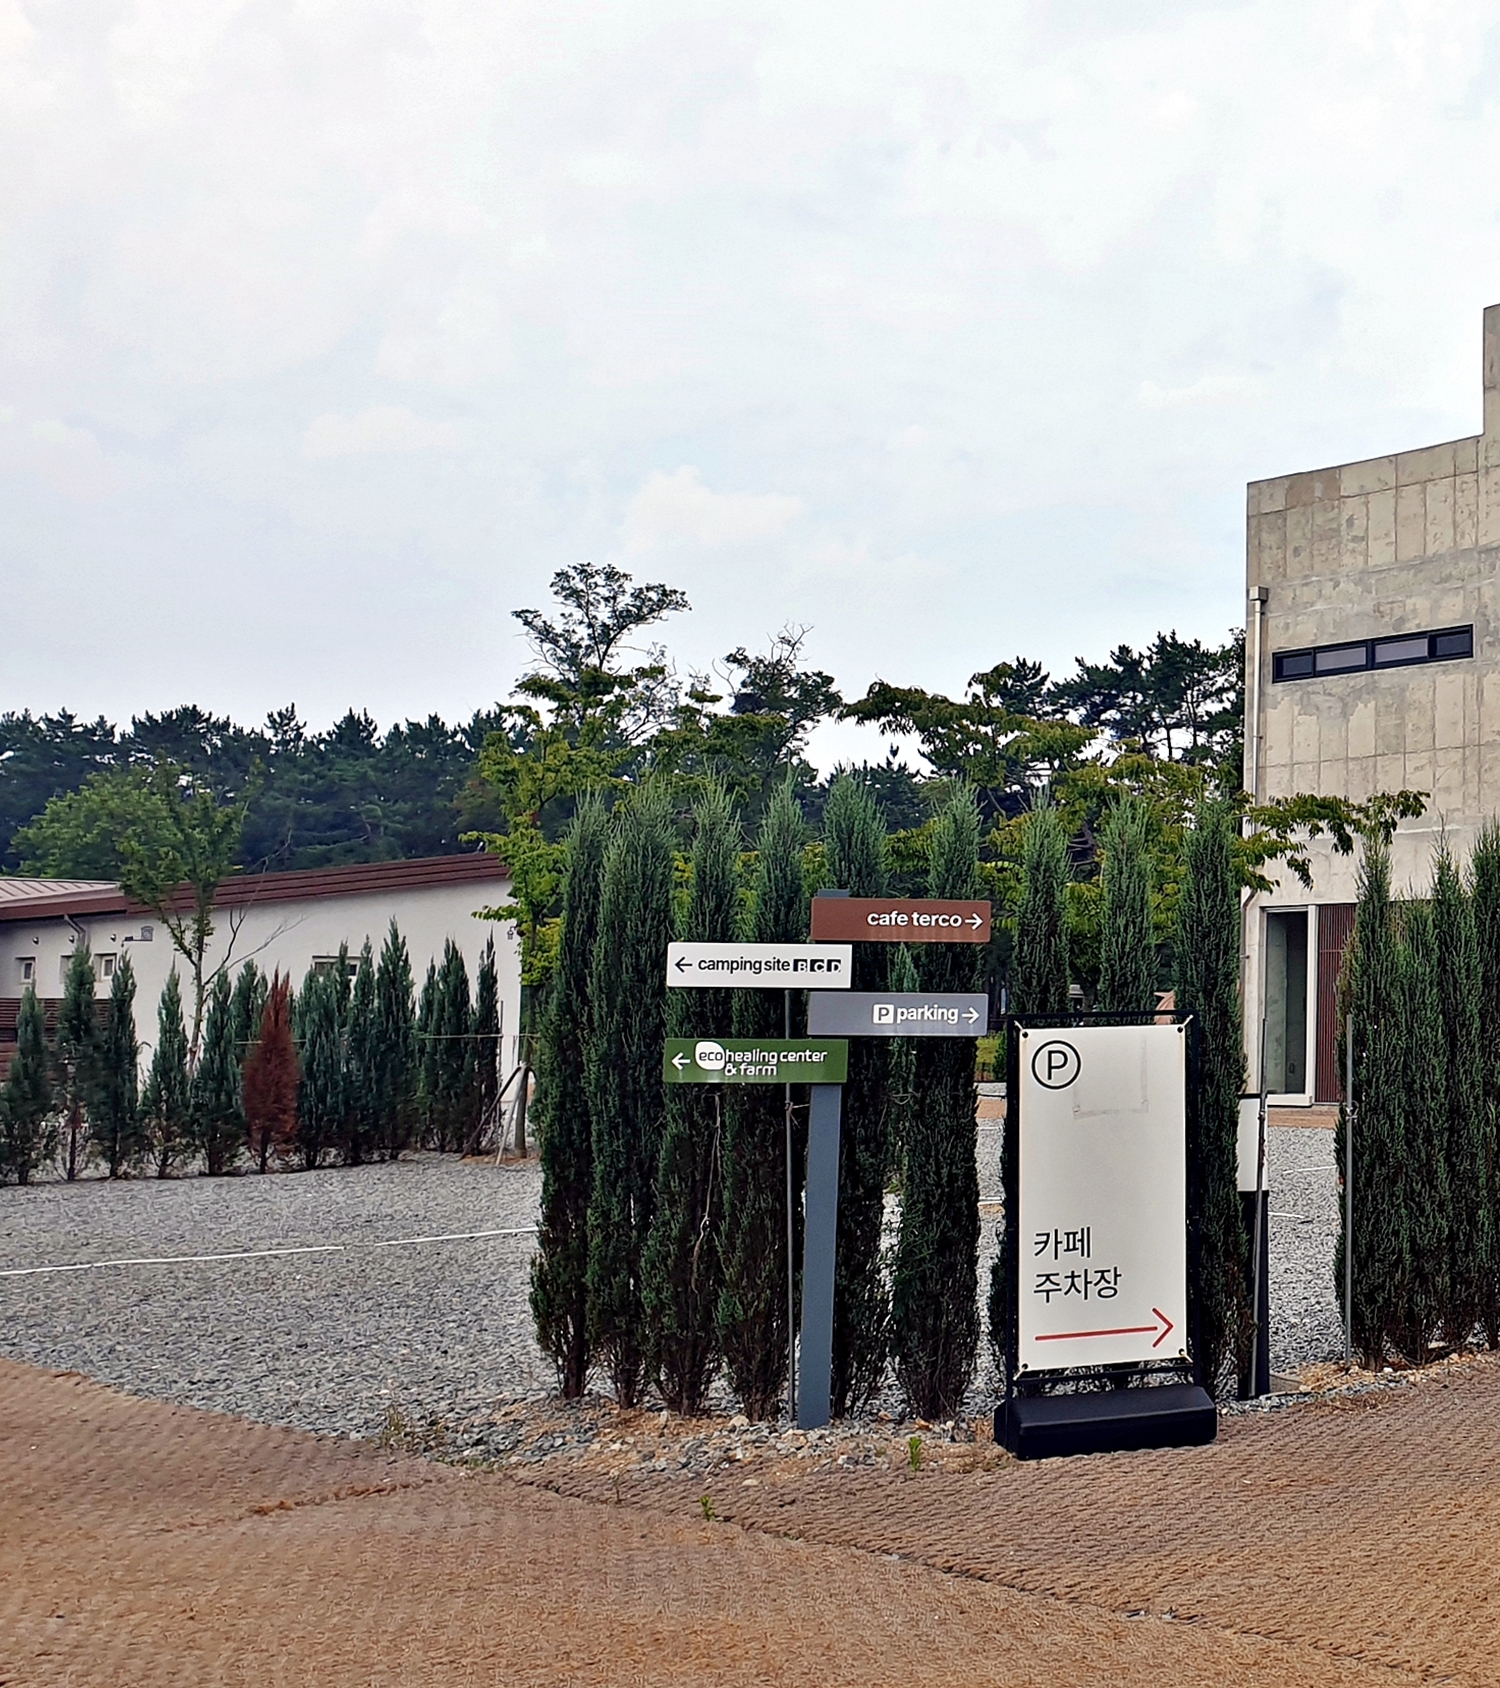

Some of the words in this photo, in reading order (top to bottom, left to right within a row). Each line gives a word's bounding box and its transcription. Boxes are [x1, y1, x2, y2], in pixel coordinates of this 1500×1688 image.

[867, 910, 909, 926] cafe
[911, 911, 962, 927] terco
[698, 956, 763, 974] camping
[764, 956, 791, 971] site
[878, 1006, 891, 1022] P
[896, 1004, 959, 1024] parking
[779, 1049, 828, 1062] center
[1046, 1049, 1069, 1081] P
[724, 1063, 737, 1076] &
[739, 1063, 777, 1076] farm
[1033, 1226, 1092, 1261] 카페
[1033, 1266, 1123, 1304] 주차장
